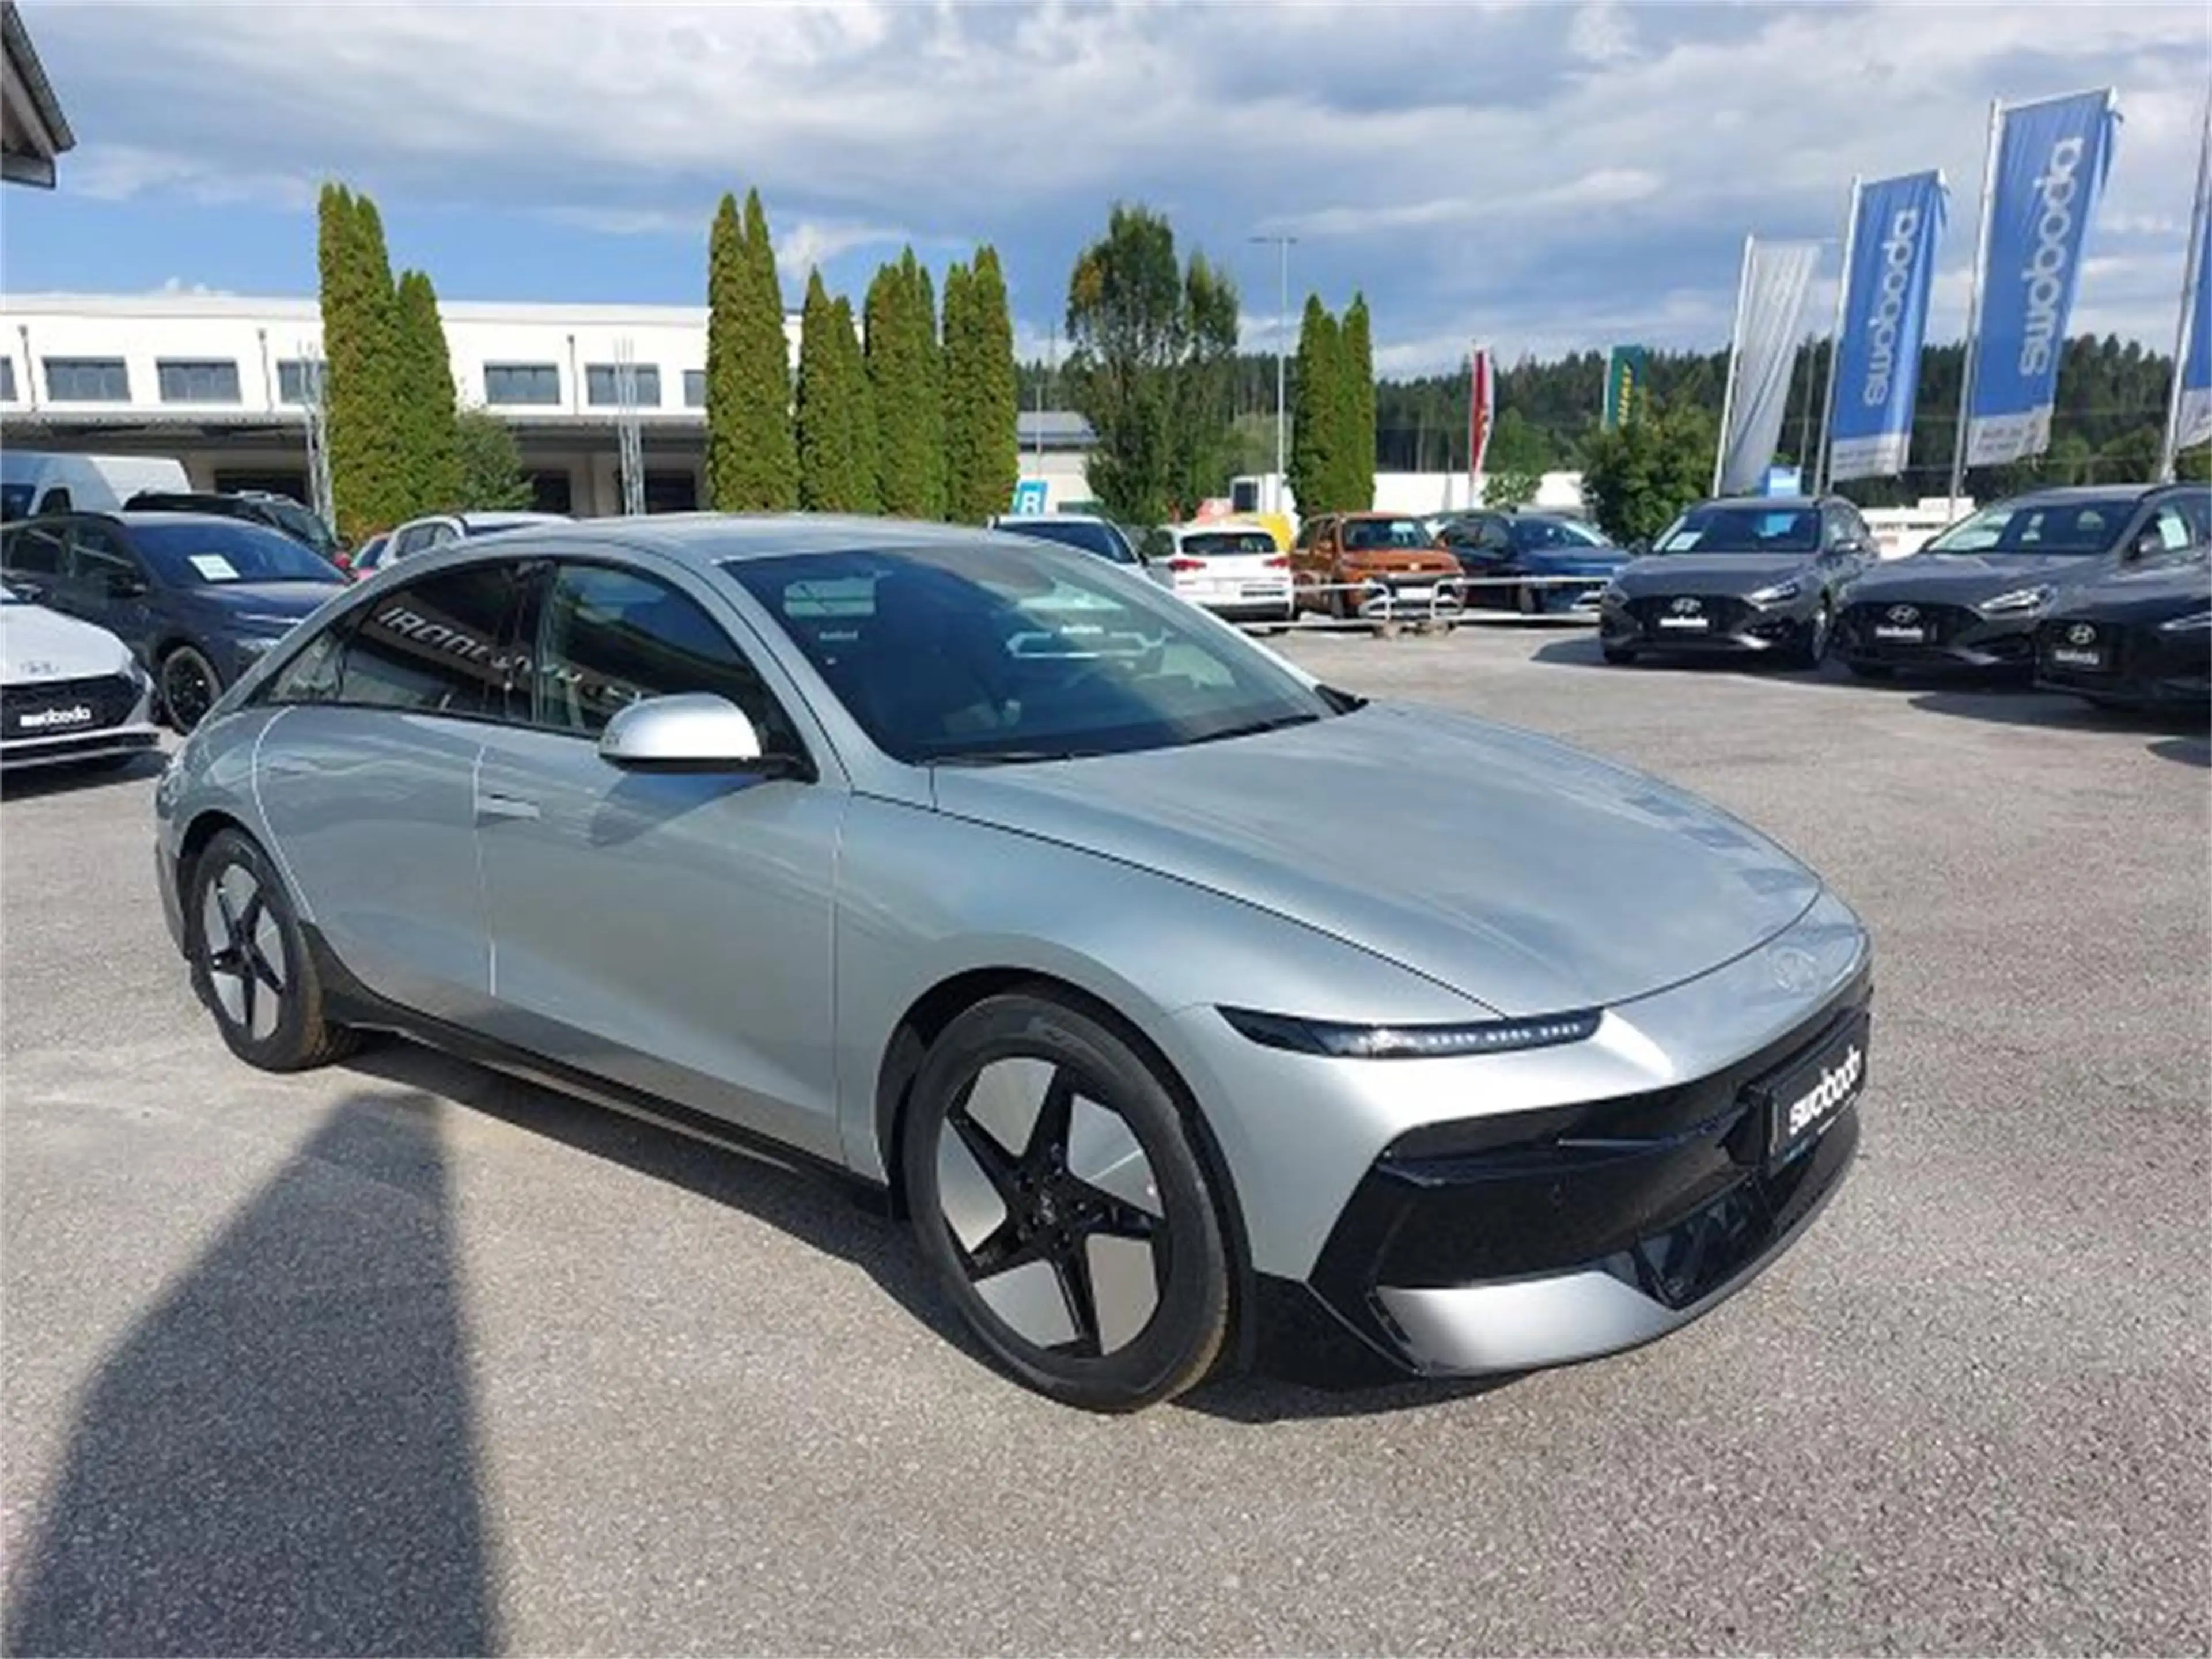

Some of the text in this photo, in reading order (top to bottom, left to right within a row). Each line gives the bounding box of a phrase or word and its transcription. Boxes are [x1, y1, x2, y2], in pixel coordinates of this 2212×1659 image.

[1863, 207, 1920, 406] swoboda
[2018, 136, 2084, 376] swoboda
[1789, 1044, 1861, 1136] swoboda
